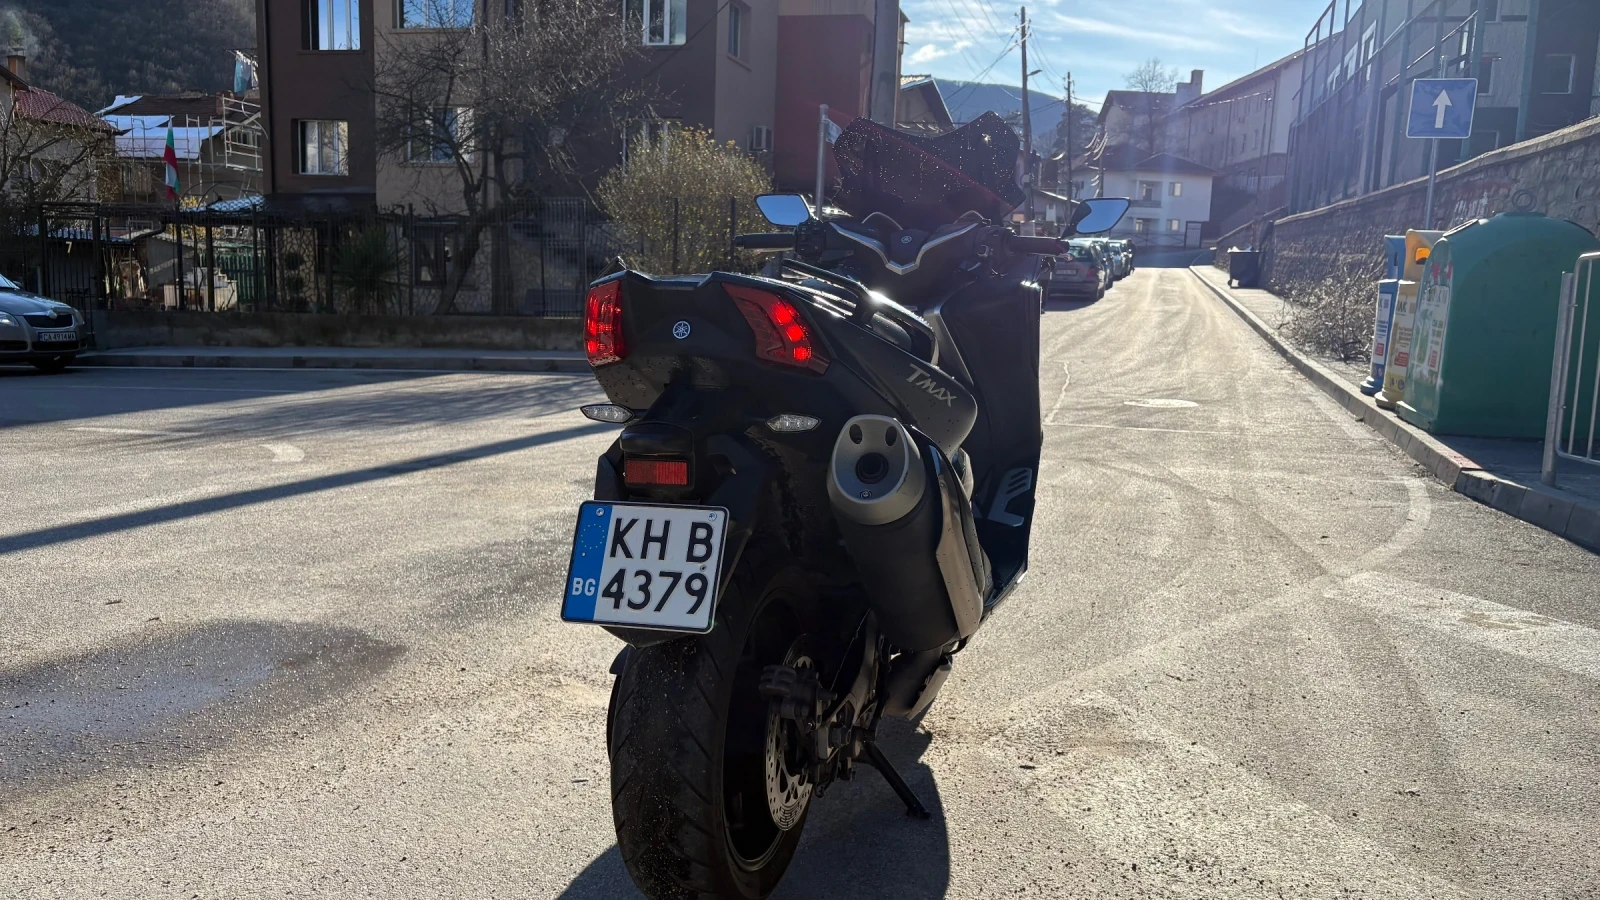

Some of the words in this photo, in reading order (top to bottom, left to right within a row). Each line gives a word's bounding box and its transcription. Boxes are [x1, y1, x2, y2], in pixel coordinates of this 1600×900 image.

[906, 363, 957, 407] TMAX
[610, 517, 671, 560] KH
[686, 521, 714, 563] B
[572, 577, 596, 596] BG
[601, 568, 709, 615] 4379
